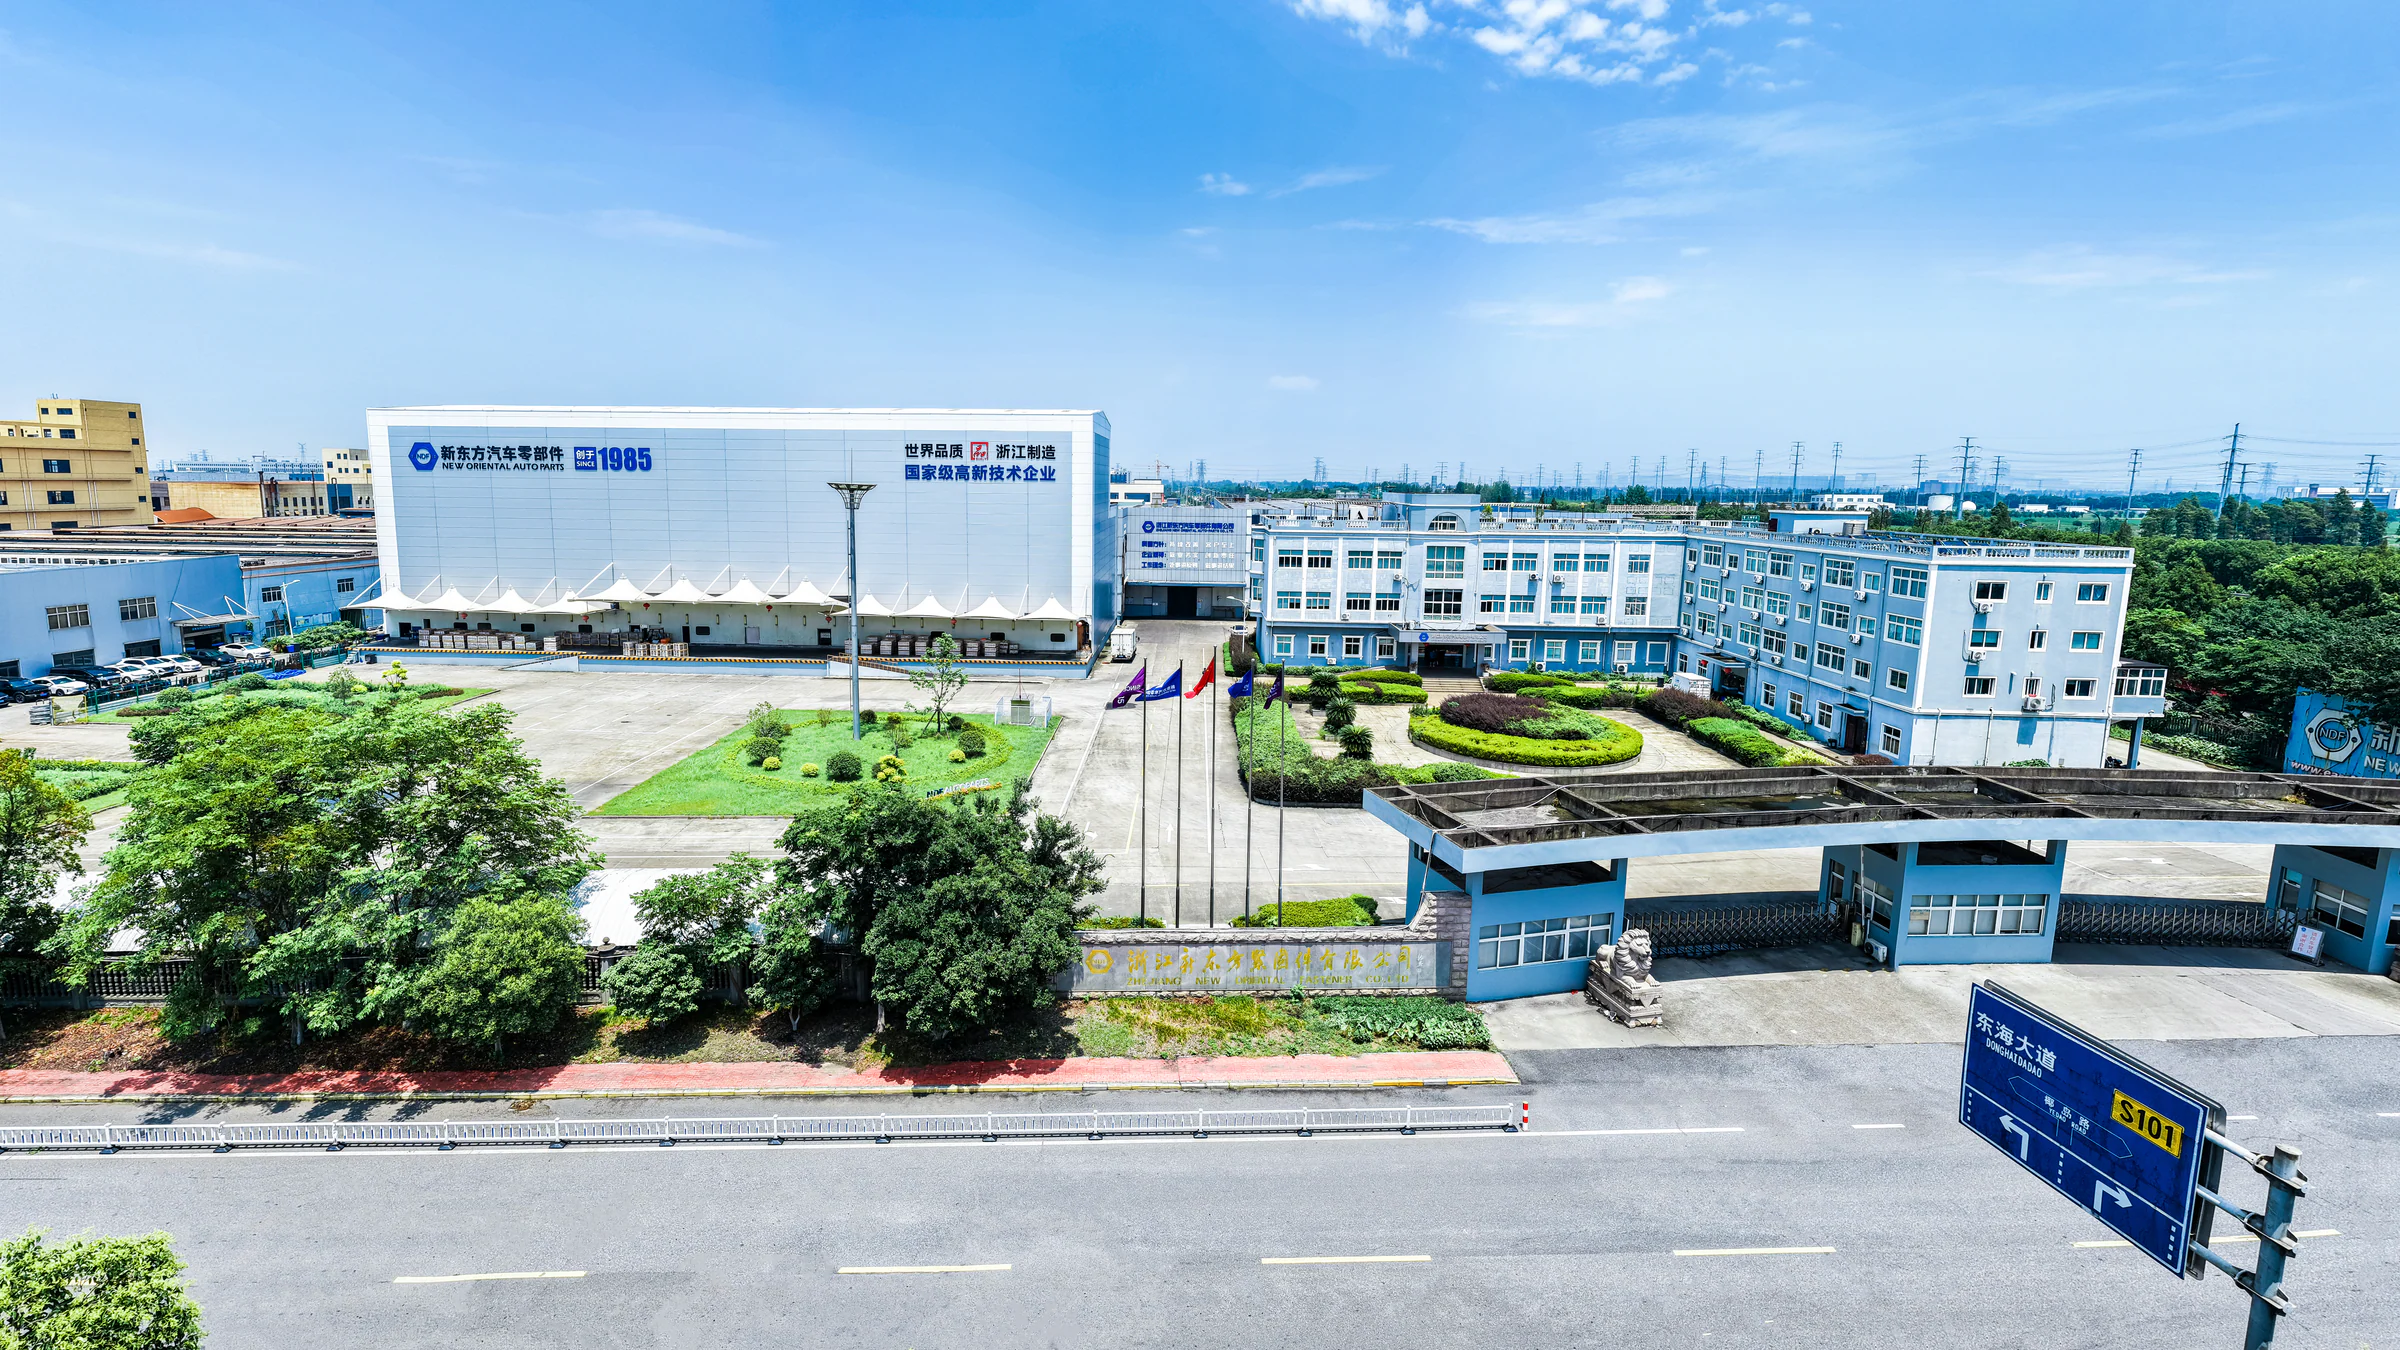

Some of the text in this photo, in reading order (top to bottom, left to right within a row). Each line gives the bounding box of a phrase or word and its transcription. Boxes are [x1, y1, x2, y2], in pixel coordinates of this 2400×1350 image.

[441, 445, 564, 462] 新东方汽车零部件
[575, 449, 595, 460] 创于
[597, 447, 652, 471] 1985
[904, 444, 1057, 460] 世界品质 浙江制造
[442, 462, 565, 471] NEW ORIENTAL AUTO PARTS
[576, 460, 595, 468] SINCE
[904, 464, 1057, 482] 国家级高新技术企业
[2319, 727, 2346, 741] NDF
[1127, 946, 1411, 975] 浙江新东方紧固件有限公司
[1195, 976, 1221, 986] NEW
[1235, 976, 1285, 986] ORIENTAL
[1299, 975, 1353, 985] FASTENER
[1975, 1011, 2057, 1073] 东海大道
[2048, 1108, 2087, 1135] YEDAO ROAD
[2119, 1099, 2174, 1149] S101
